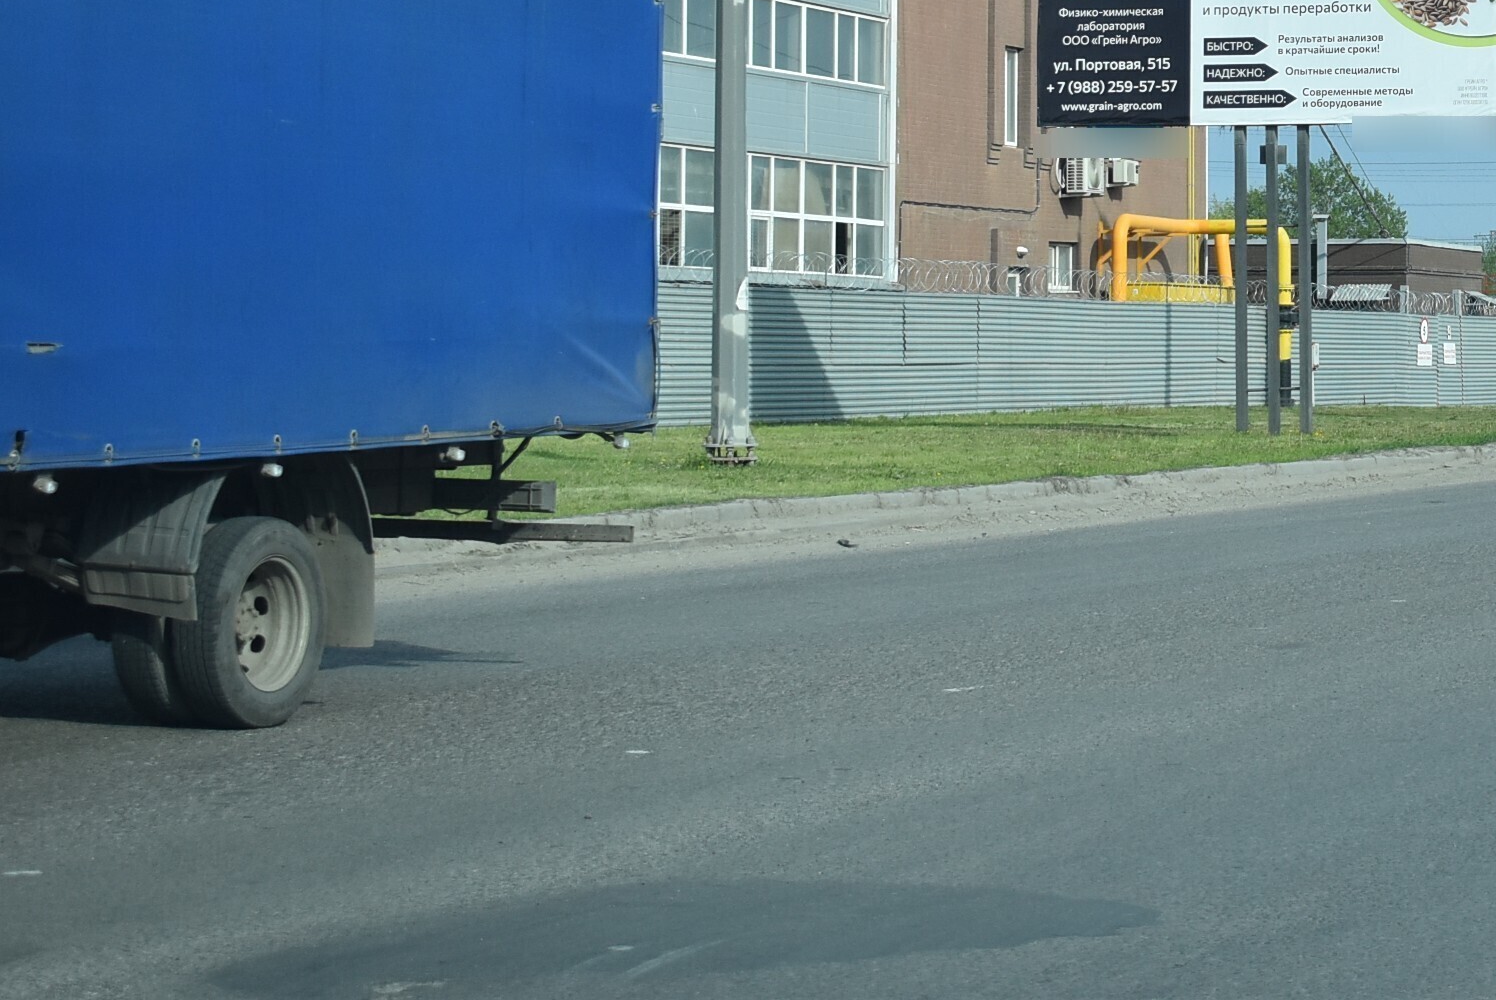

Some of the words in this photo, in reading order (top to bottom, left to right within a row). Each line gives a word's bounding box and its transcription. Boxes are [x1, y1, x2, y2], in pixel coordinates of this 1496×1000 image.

[1058, 7, 1164, 18] Физико-химическая
[1202, 6, 1211, 16] и
[1213, 5, 1280, 18] продукты
[1283, 1, 1372, 16] переработки
[1076, 21, 1145, 33] лаборатория
[1062, 35, 1090, 46] ООО
[1091, 35, 1128, 47] «Грейн
[1129, 35, 1162, 46] Агро»
[1278, 34, 1335, 45] Результаты
[1337, 34, 1384, 43] анализов
[1206, 41, 1254, 52] БЫСТРО:
[1278, 47, 1284, 55] в
[1285, 45, 1346, 56] кратчайшие
[1347, 44, 1380, 56] сроки!
[1053, 61, 1073, 74] ул.
[1075, 59, 1145, 74] Портовая,
[1147, 58, 1171, 70] 515
[1285, 66, 1333, 76] Опытные
[1334, 66, 1400, 76] специалисты
[1206, 68, 1266, 80] НАДЕЖНО:
[1068, 80, 1105, 95] (988)
[1107, 80, 1178, 93] 259-57-57
[1302, 88, 1372, 98] Современные
[1374, 87, 1414, 97] методы
[1206, 94, 1287, 105] КАЧЕСТВЕННО:
[1310, 99, 1383, 110] оборудование
[1061, 101, 1163, 113] www.grain-agro.com
